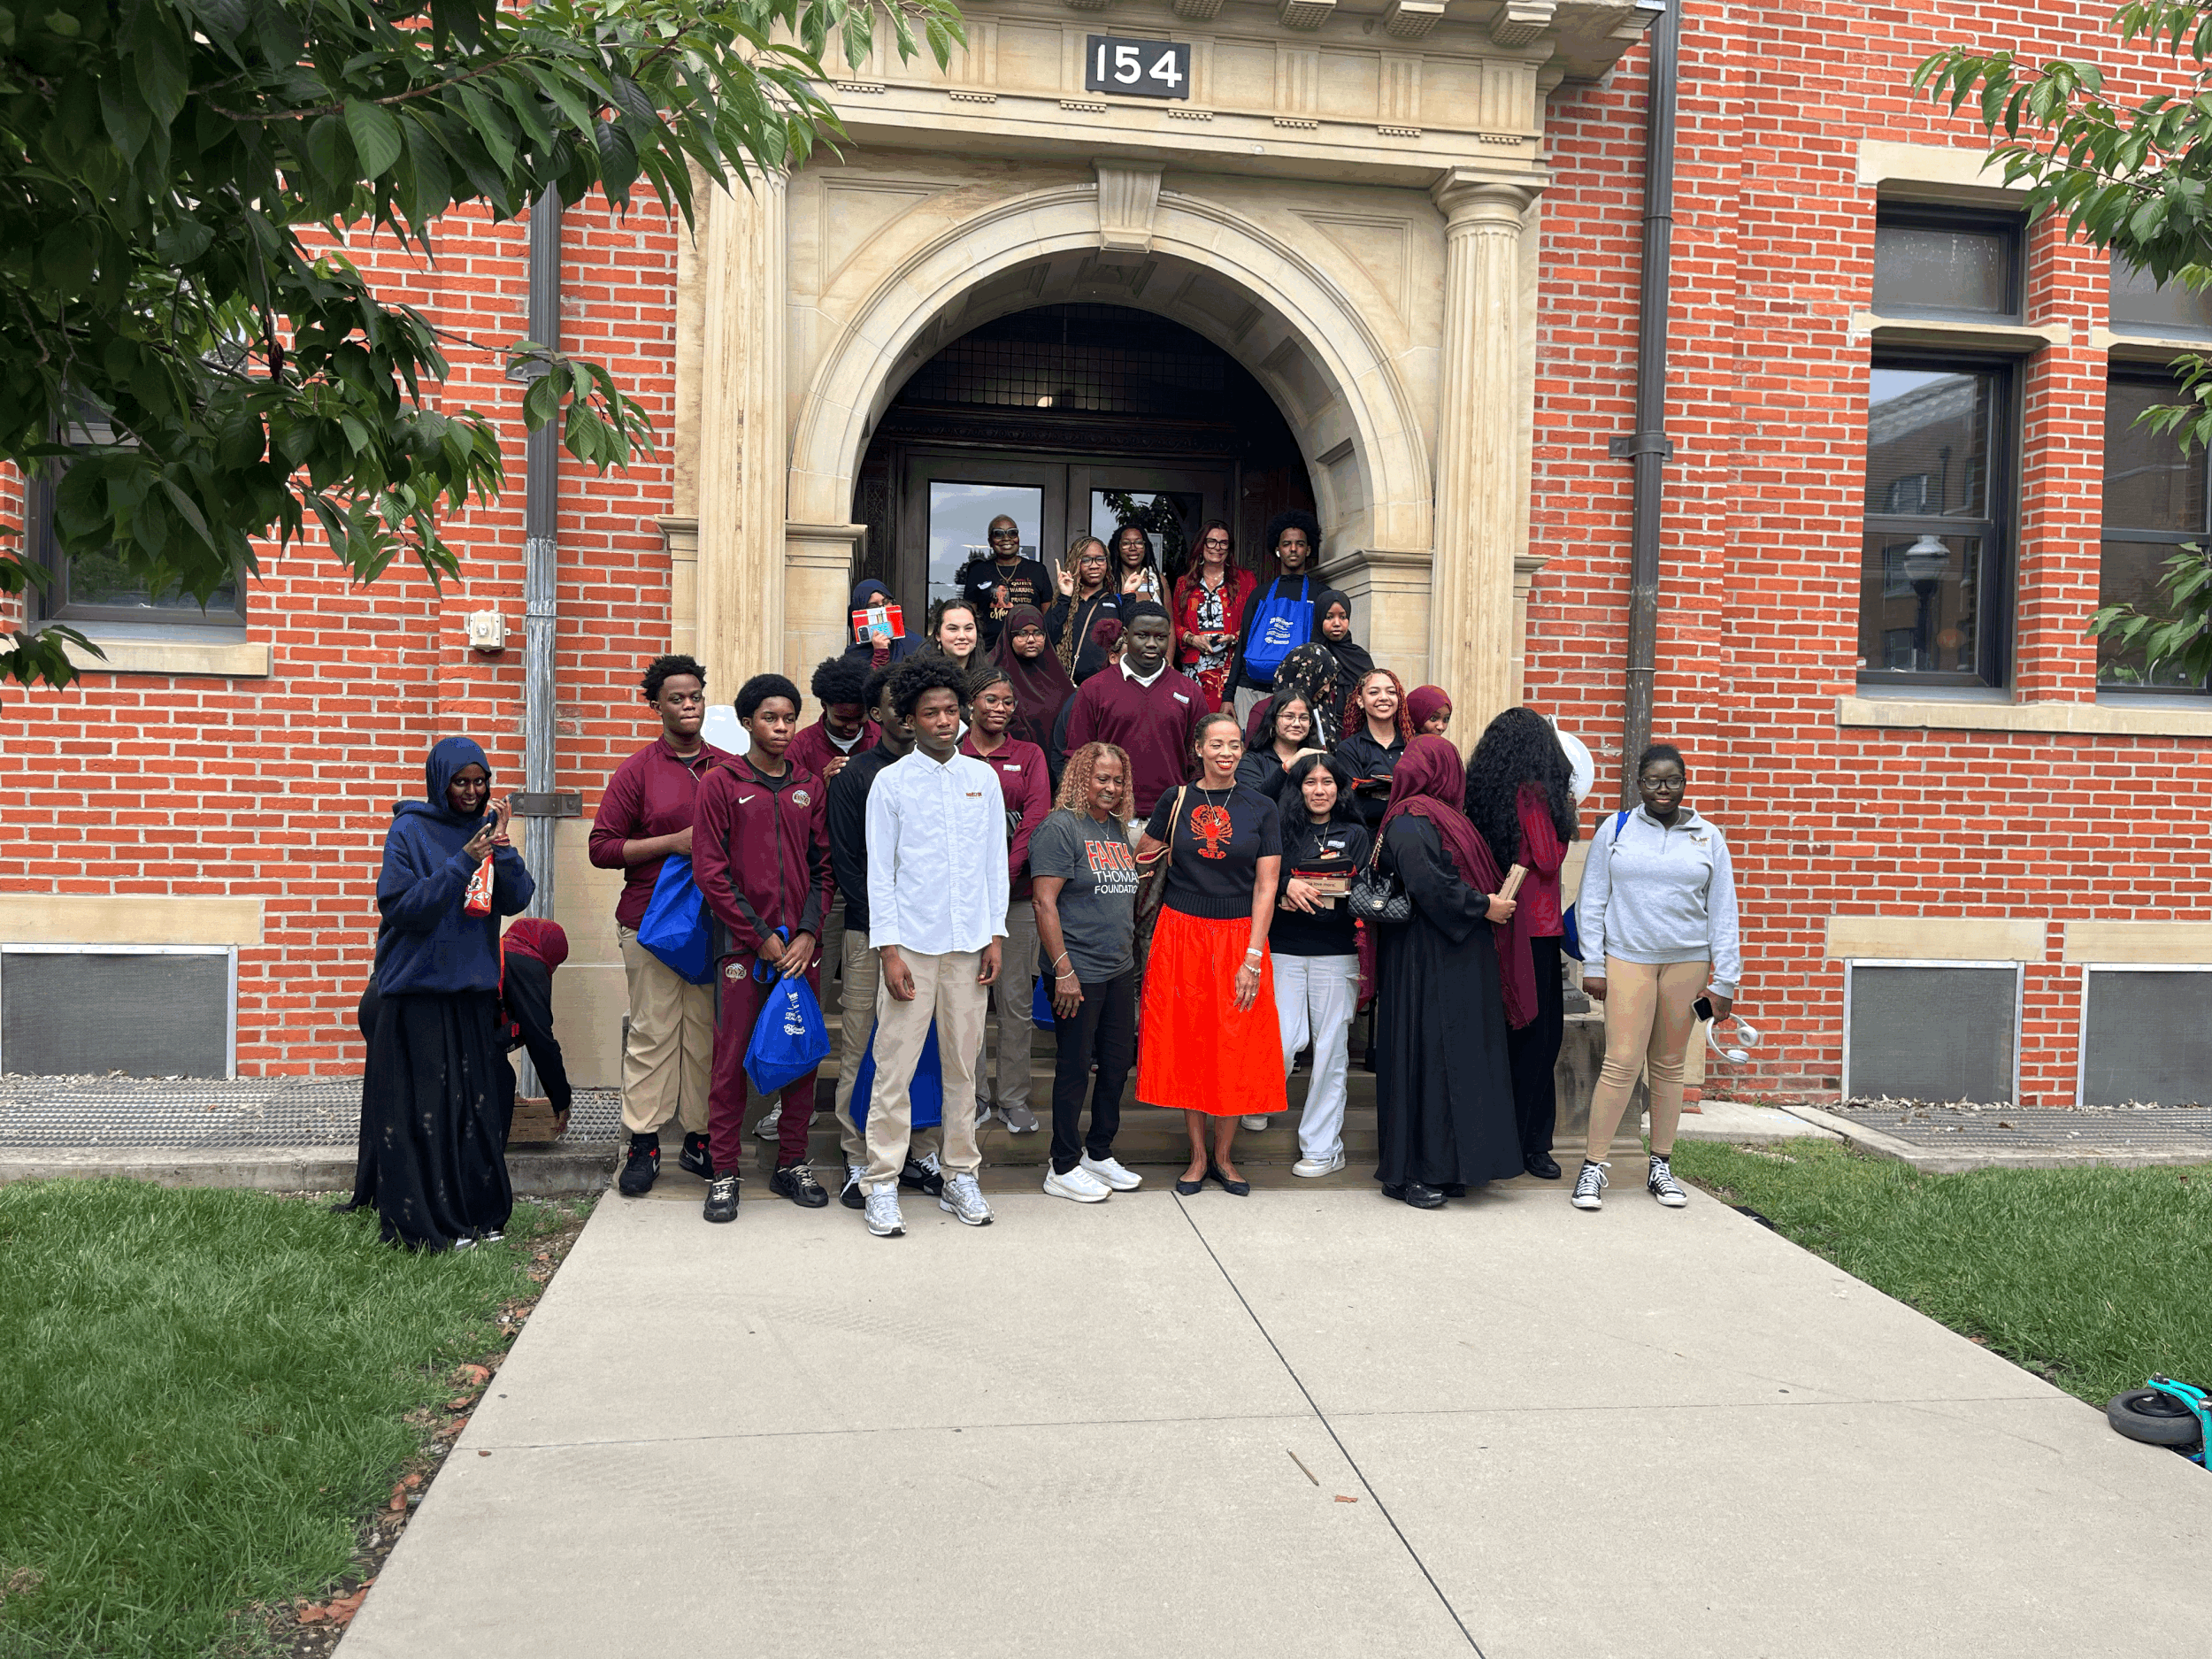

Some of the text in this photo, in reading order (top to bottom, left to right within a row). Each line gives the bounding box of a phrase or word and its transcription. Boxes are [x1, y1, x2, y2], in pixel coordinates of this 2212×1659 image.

[1097, 44, 1182, 88] 154
[1085, 841, 1134, 871] FAITH
[1093, 871, 1140, 884] THOMA
